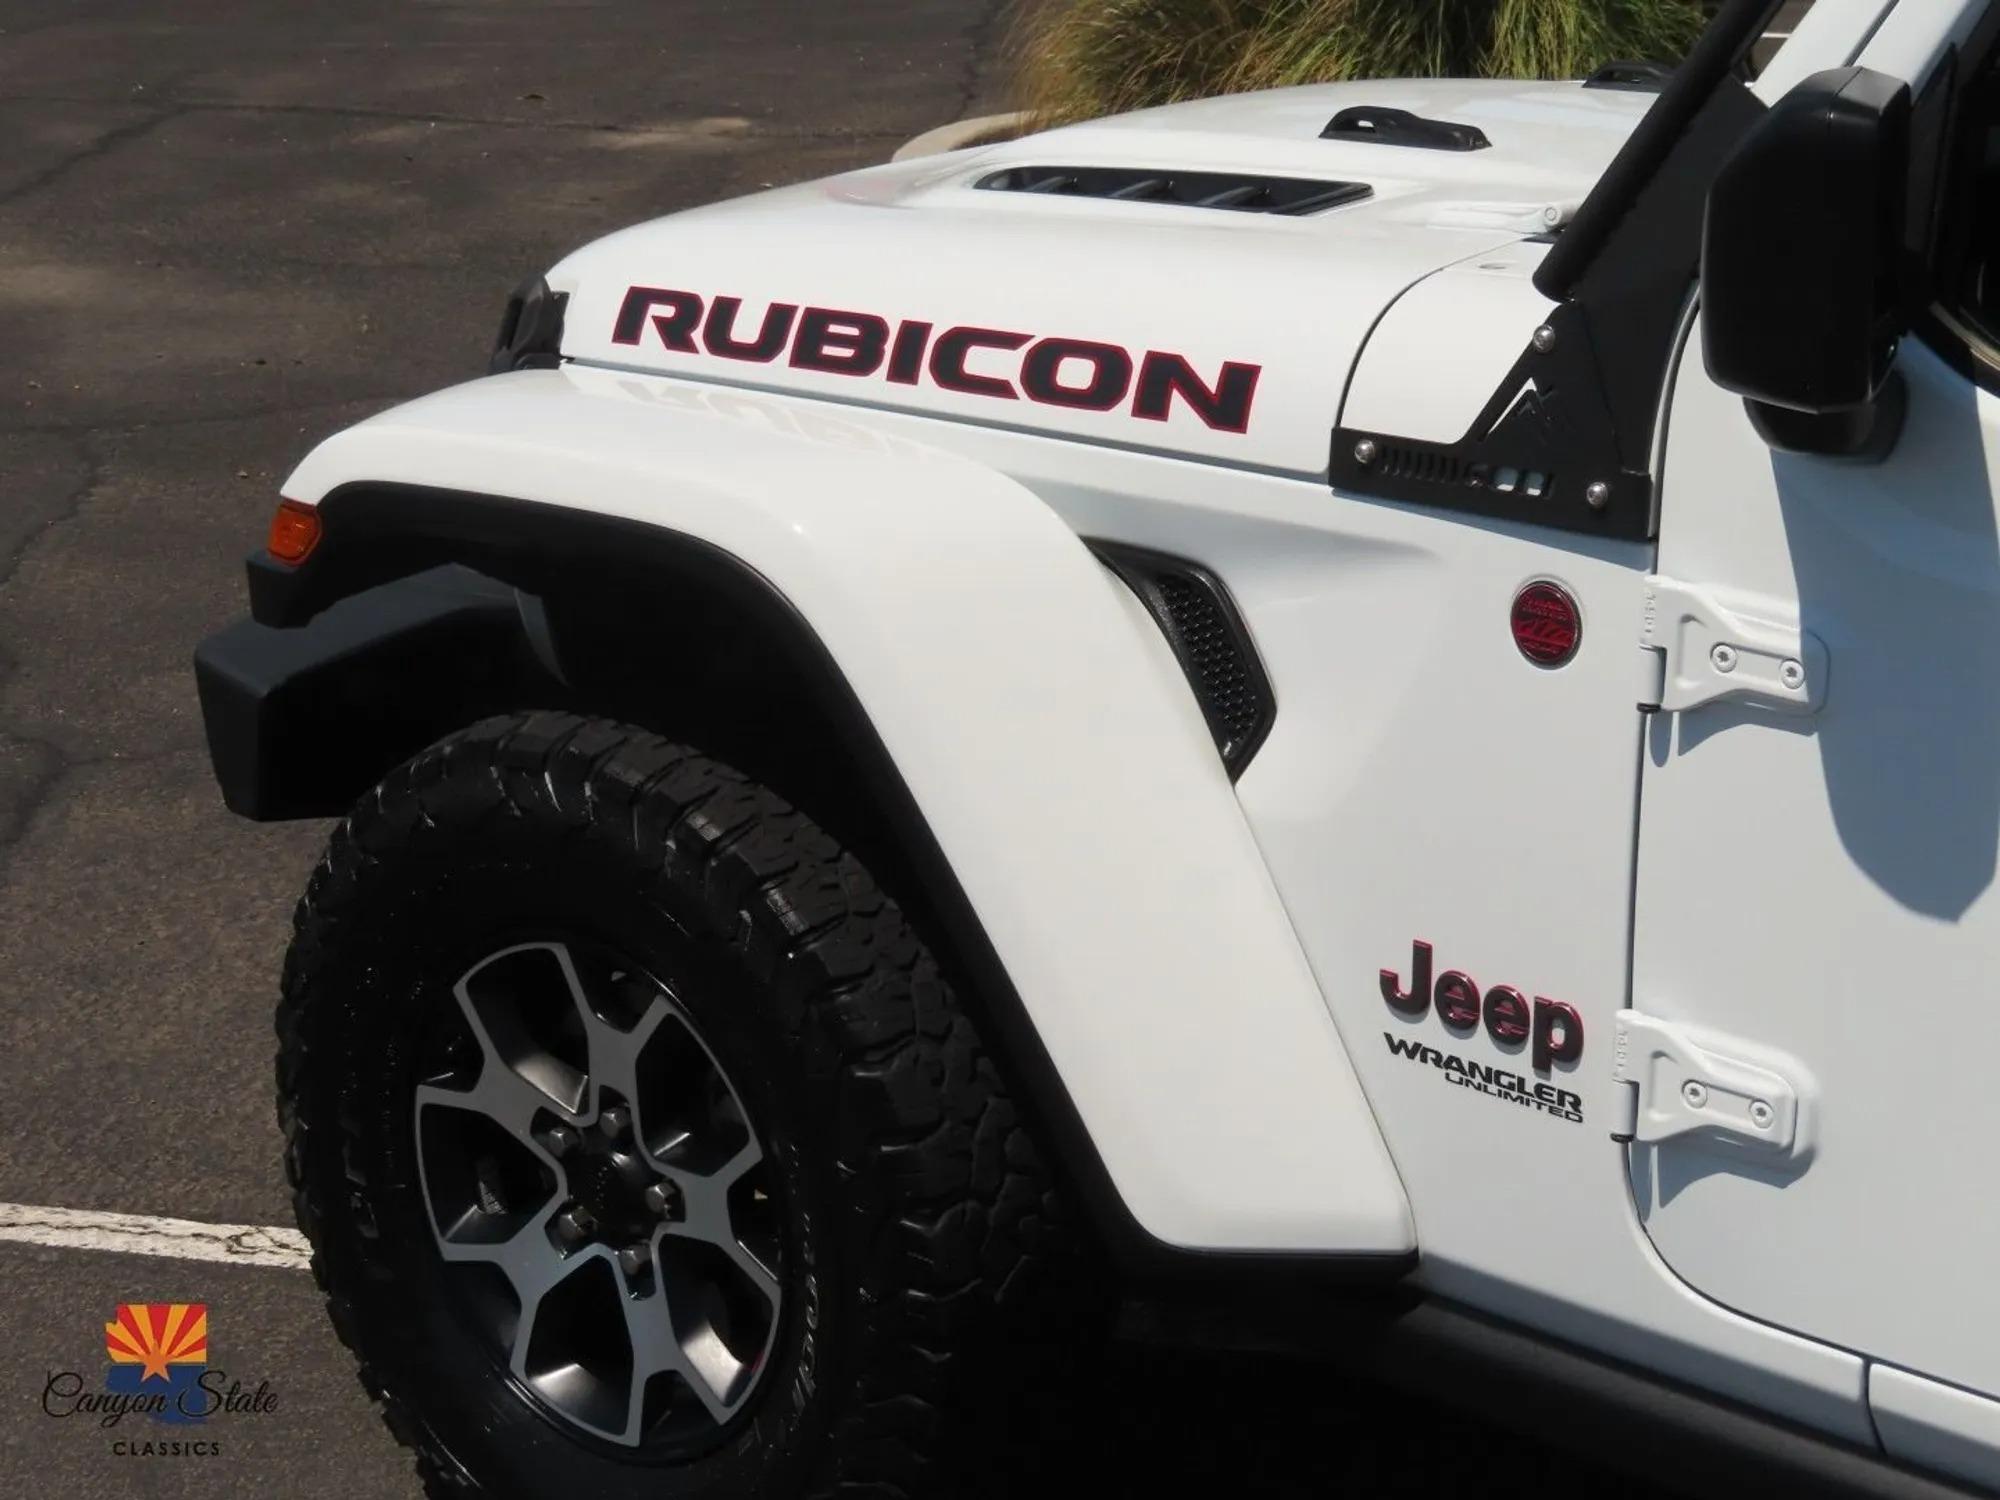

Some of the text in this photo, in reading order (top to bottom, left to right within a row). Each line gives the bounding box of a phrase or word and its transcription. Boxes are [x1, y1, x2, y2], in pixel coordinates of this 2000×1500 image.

[612, 286, 1262, 434] RUBICON
[1379, 939, 1584, 1073] Jeep
[1384, 1032, 1583, 1114] WRANGLER
[1445, 1072, 1583, 1124] UNLIMITED
